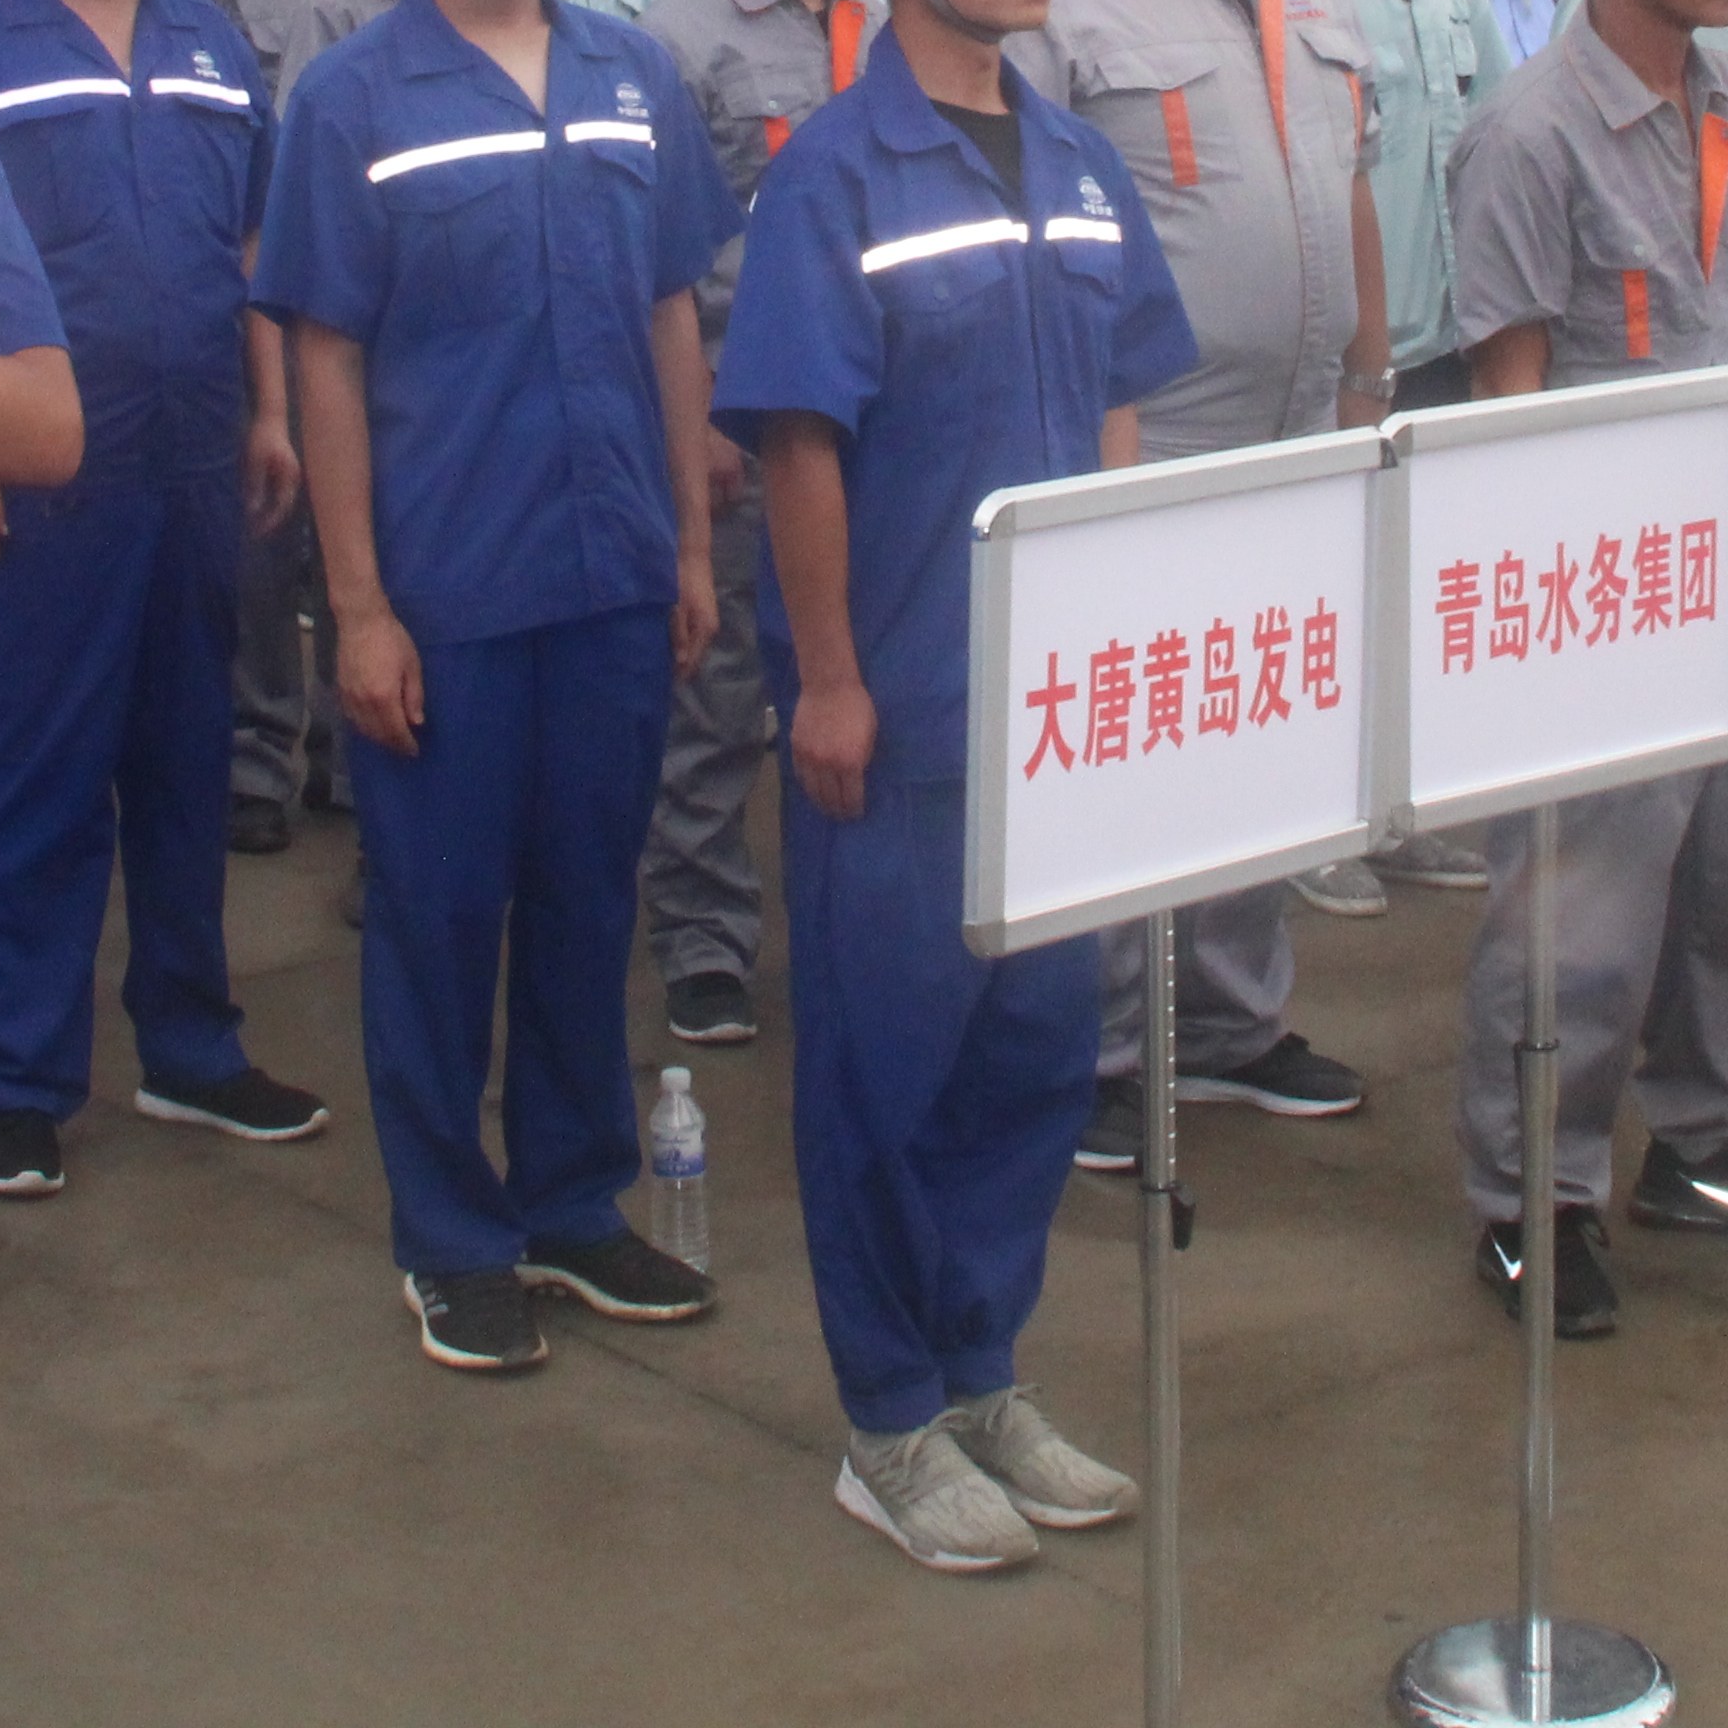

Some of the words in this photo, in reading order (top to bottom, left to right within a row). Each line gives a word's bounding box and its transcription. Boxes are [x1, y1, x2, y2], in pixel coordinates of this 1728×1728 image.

[1434, 517, 1718, 676] 青岛水务集团
[1022, 596, 1342, 782] 大唐黄岛发电
